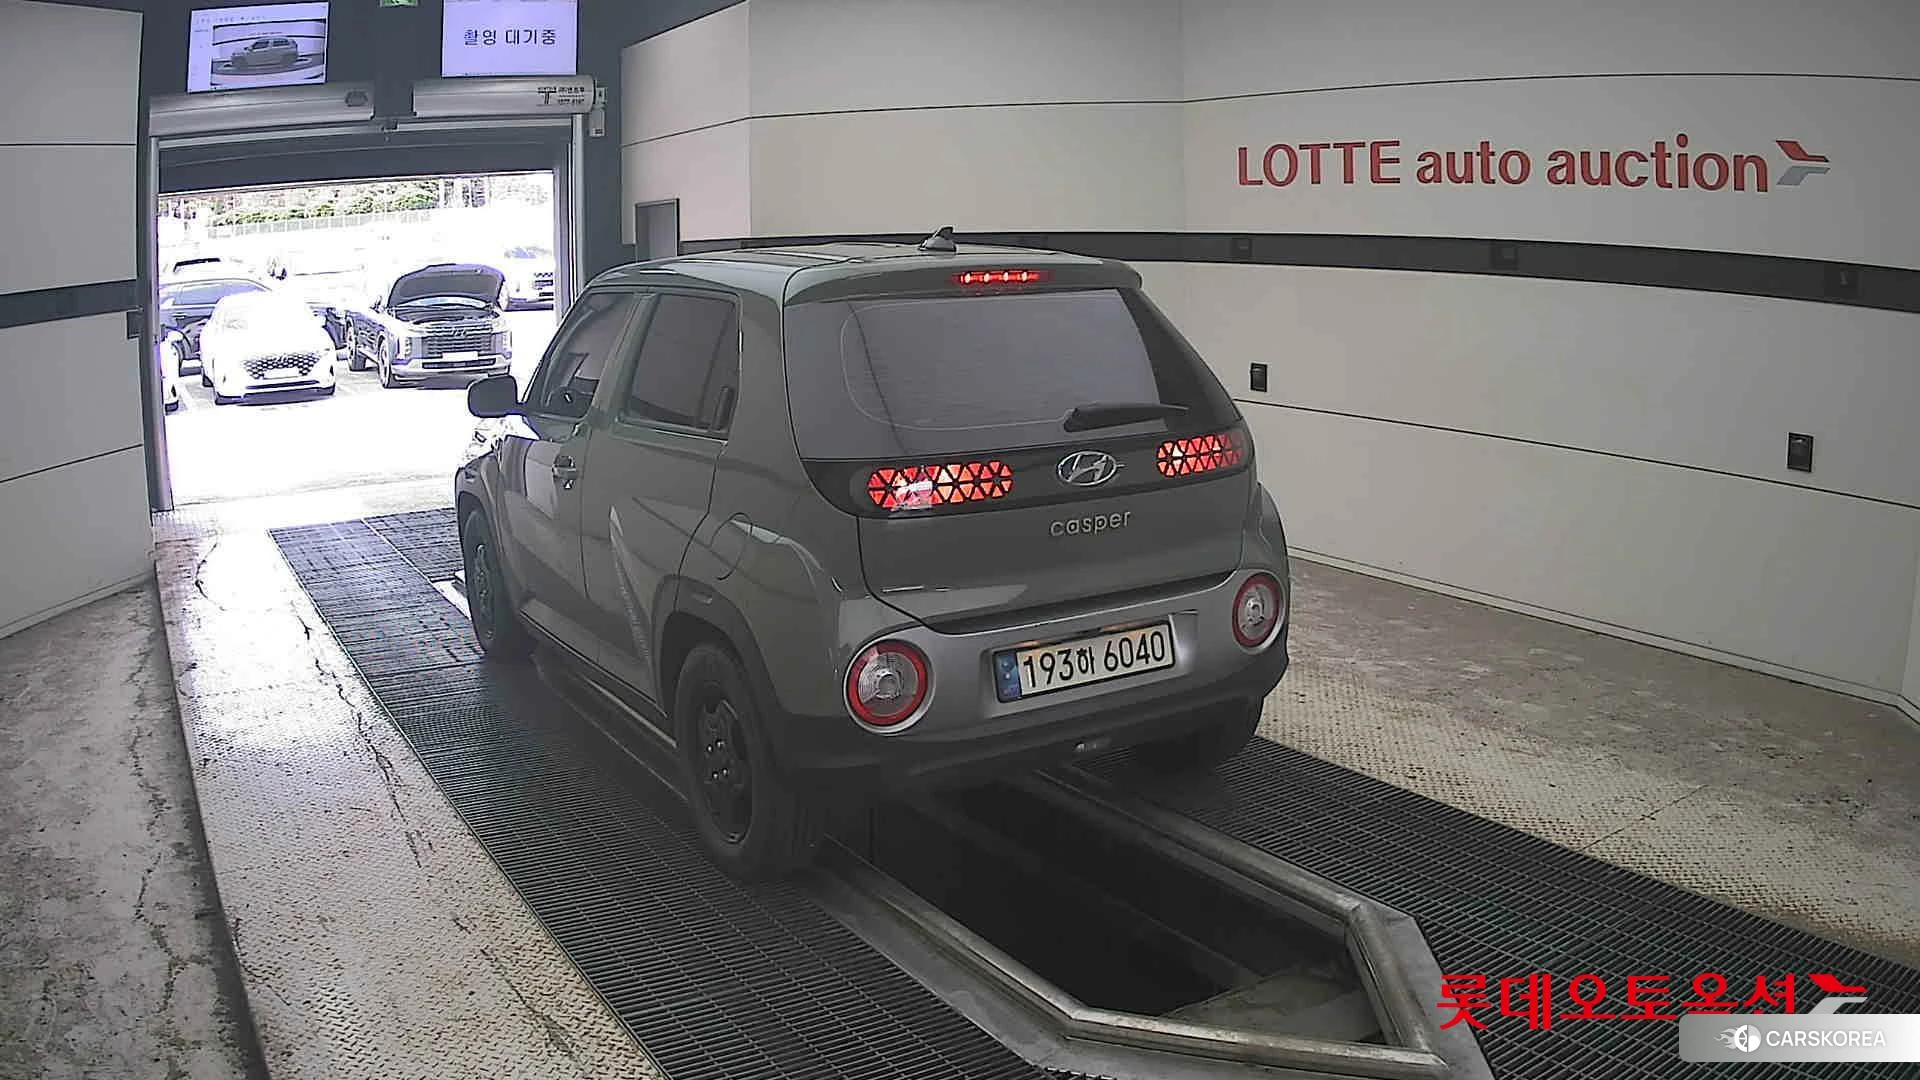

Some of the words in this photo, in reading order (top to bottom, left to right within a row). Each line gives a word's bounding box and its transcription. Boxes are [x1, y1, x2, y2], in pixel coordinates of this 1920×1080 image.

[505, 29, 557, 46] 대기중
[1238, 140, 1401, 188] LOTTE
[1416, 140, 1532, 186] auto
[1546, 133, 1769, 193] auction
[1049, 511, 1132, 537] casper
[1022, 646, 1096, 689] 193하
[1103, 630, 1166, 673] 6040
